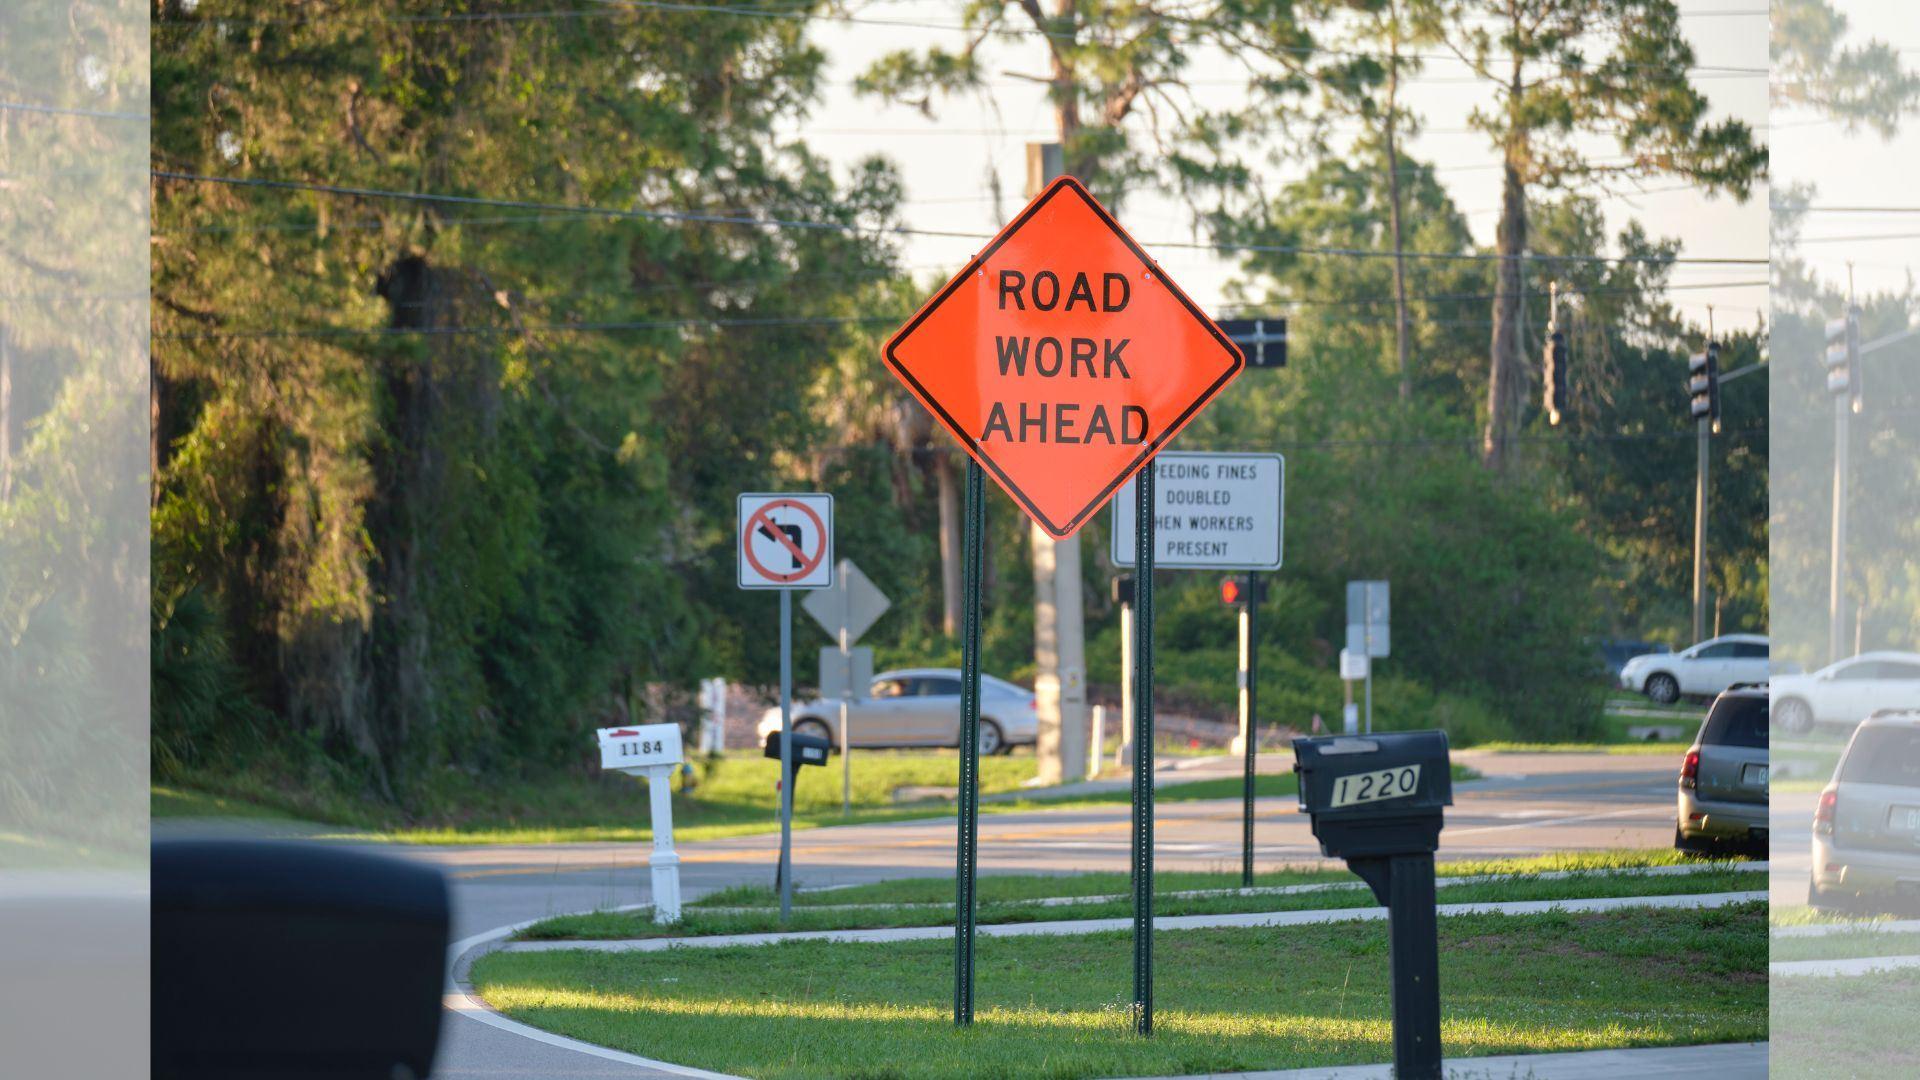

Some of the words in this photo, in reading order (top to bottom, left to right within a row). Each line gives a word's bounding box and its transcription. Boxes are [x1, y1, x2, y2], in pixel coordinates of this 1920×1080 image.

[998, 269, 1131, 313] ROAD
[995, 335, 1132, 379] WORK
[980, 401, 1150, 445] AHEAD
[1154, 463, 1210, 480] EEDING
[1216, 464, 1257, 480] FINES
[1166, 490, 1231, 506] DOUBLED
[1154, 515, 1182, 531] HEN
[1189, 516, 1254, 531] WORKERS
[1166, 541, 1229, 557] PRESENT
[620, 740, 663, 757] 1184
[1340, 767, 1416, 804] 1220
